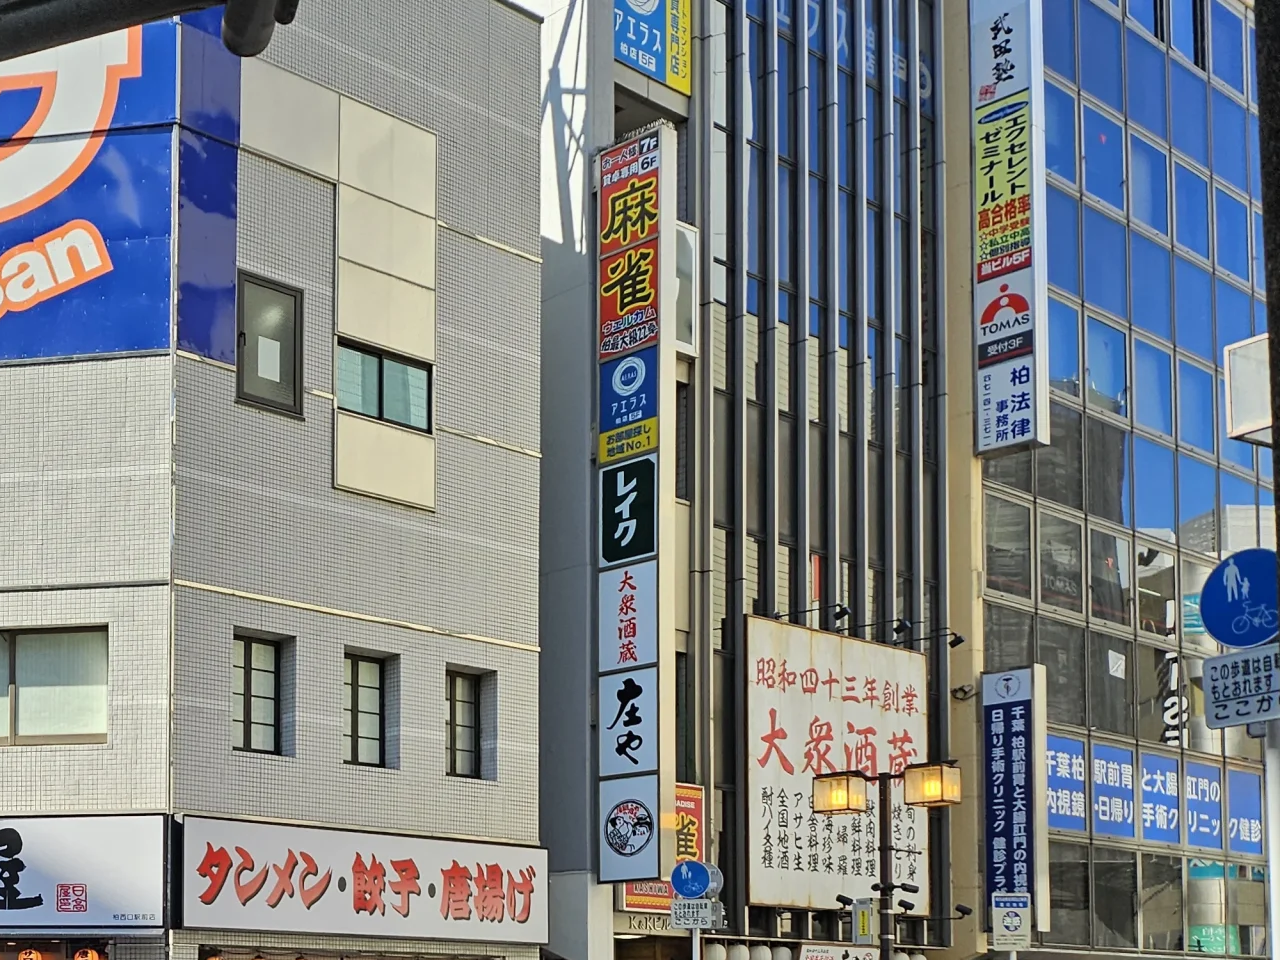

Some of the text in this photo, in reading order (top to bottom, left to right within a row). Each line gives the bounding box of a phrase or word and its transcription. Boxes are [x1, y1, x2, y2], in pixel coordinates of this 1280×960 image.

[614, 8, 662, 54] アエラス
[640, 54, 653, 68] 5F
[602, 137, 657, 170] お一人様 7F
[641, 156, 657, 170] 6F
[980, 126, 1004, 207] ゼミナール
[1004, 113, 1028, 196] エクセレント
[978, 194, 1031, 231] 高合格率
[601, 177, 658, 314] 麻雀
[981, 248, 1030, 275] 当ビル5F
[600, 321, 658, 353] 柏最大級22卓
[602, 306, 657, 335] ウェルカム
[980, 313, 1030, 337] TOMAS
[987, 337, 1023, 357] 受付3F
[612, 393, 646, 415] アエラス
[996, 399, 1008, 442] 事務所
[1010, 365, 1031, 439] 柏法律
[607, 424, 651, 445] お部屋探し
[613, 470, 637, 547] レイク
[618, 570, 637, 665] 大衆酒蔵
[755, 656, 919, 717] 昭和四十三年創業
[1210, 654, 1280, 682] この歩道は自
[1211, 673, 1273, 701] もとおれます
[607, 678, 643, 764] 庄や
[1215, 694, 1280, 720] ここか
[757, 707, 918, 788] 大衆酒蔵
[991, 709, 1005, 832] 日帰り手術クリニック
[761, 786, 774, 869] 酎ハイ各種
[777, 788, 789, 870] 全国地酒
[793, 792, 805, 872] アサヒ生
[195, 841, 538, 924] タンメン・餃子・唐揚げ
[633, 882, 669, 896] KASHIWA
[112, 913, 156, 921] 柏西口駅前店
[674, 917, 708, 926] ここから
